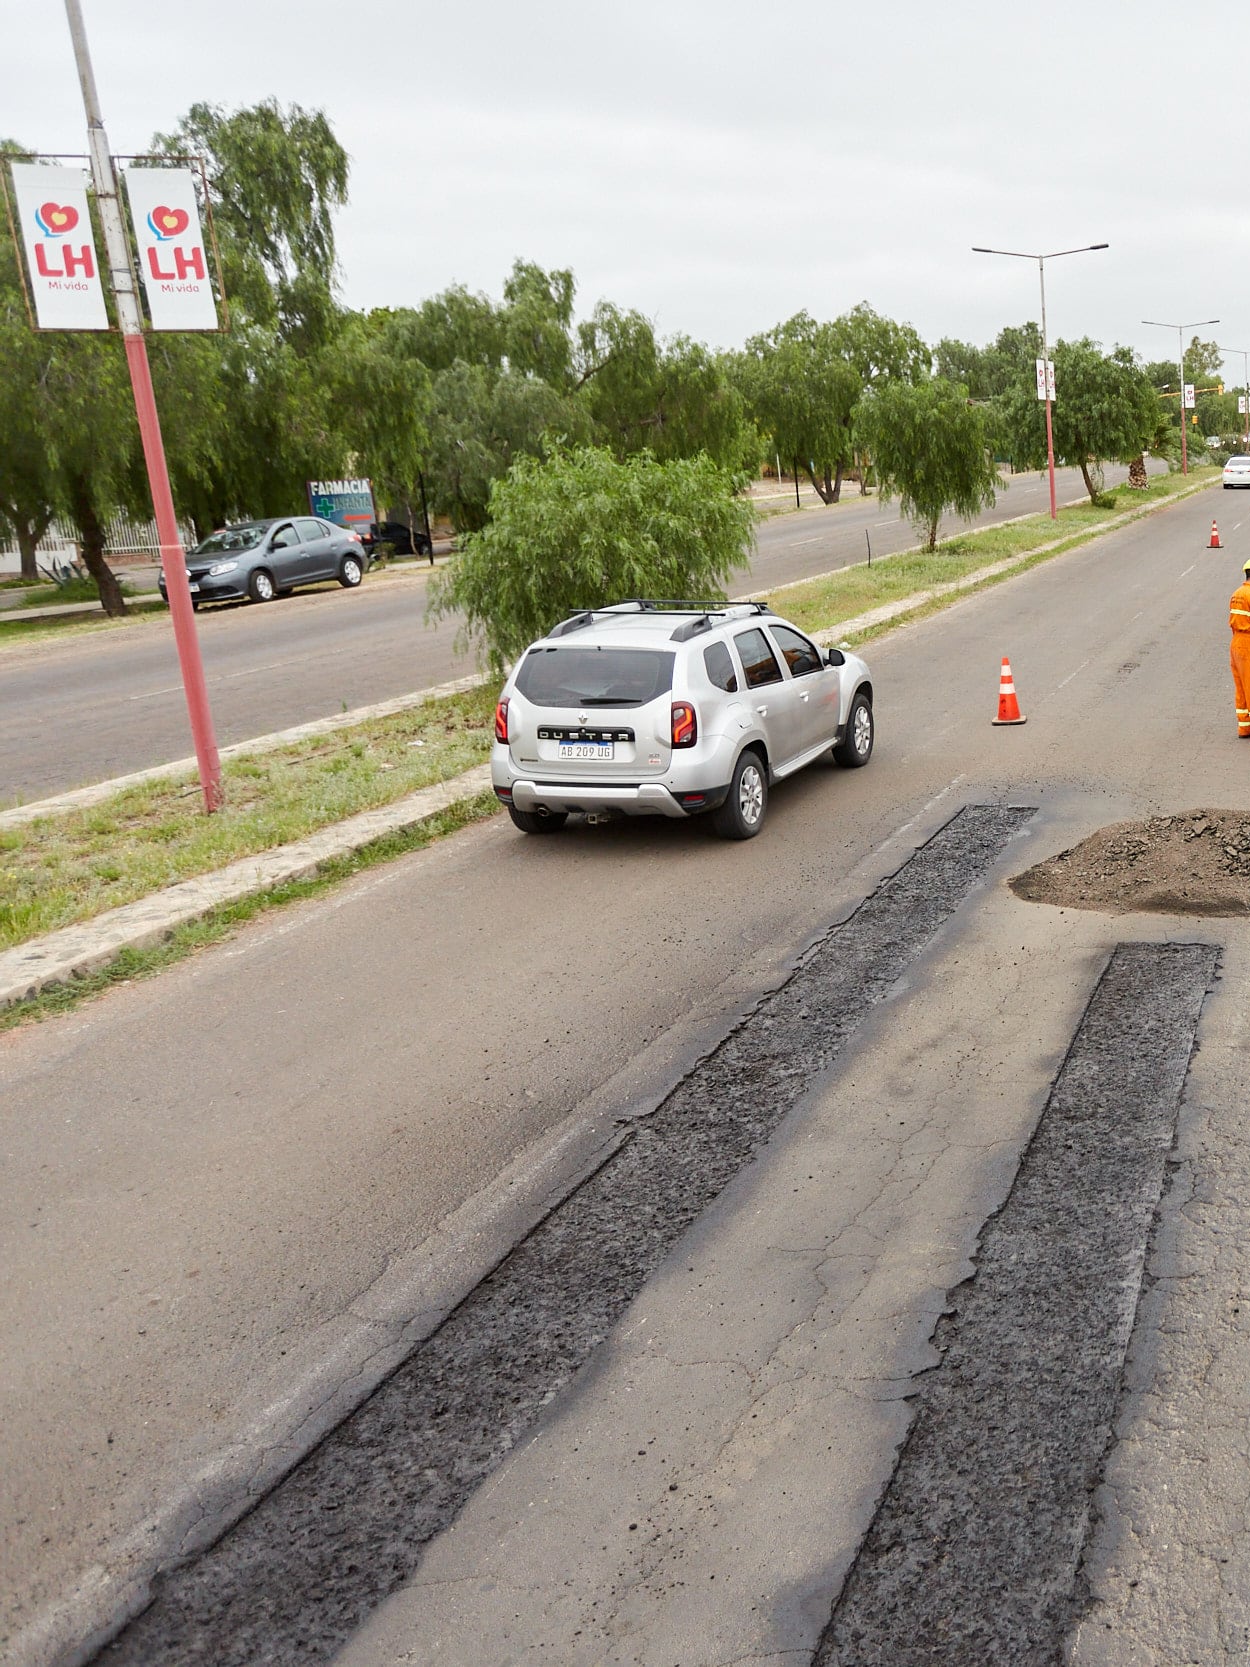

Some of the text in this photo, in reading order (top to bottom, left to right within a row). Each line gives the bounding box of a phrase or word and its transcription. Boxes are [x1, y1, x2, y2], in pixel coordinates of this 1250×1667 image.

[34, 243, 95, 279] LH
[147, 247, 205, 280] LH
[48, 281, 89, 291] Mi vida
[161, 284, 200, 293] Mi vida
[310, 479, 370, 496] FARMACIA
[539, 731, 629, 741] DUSTER
[561, 746, 611, 758] AB 209 UG
